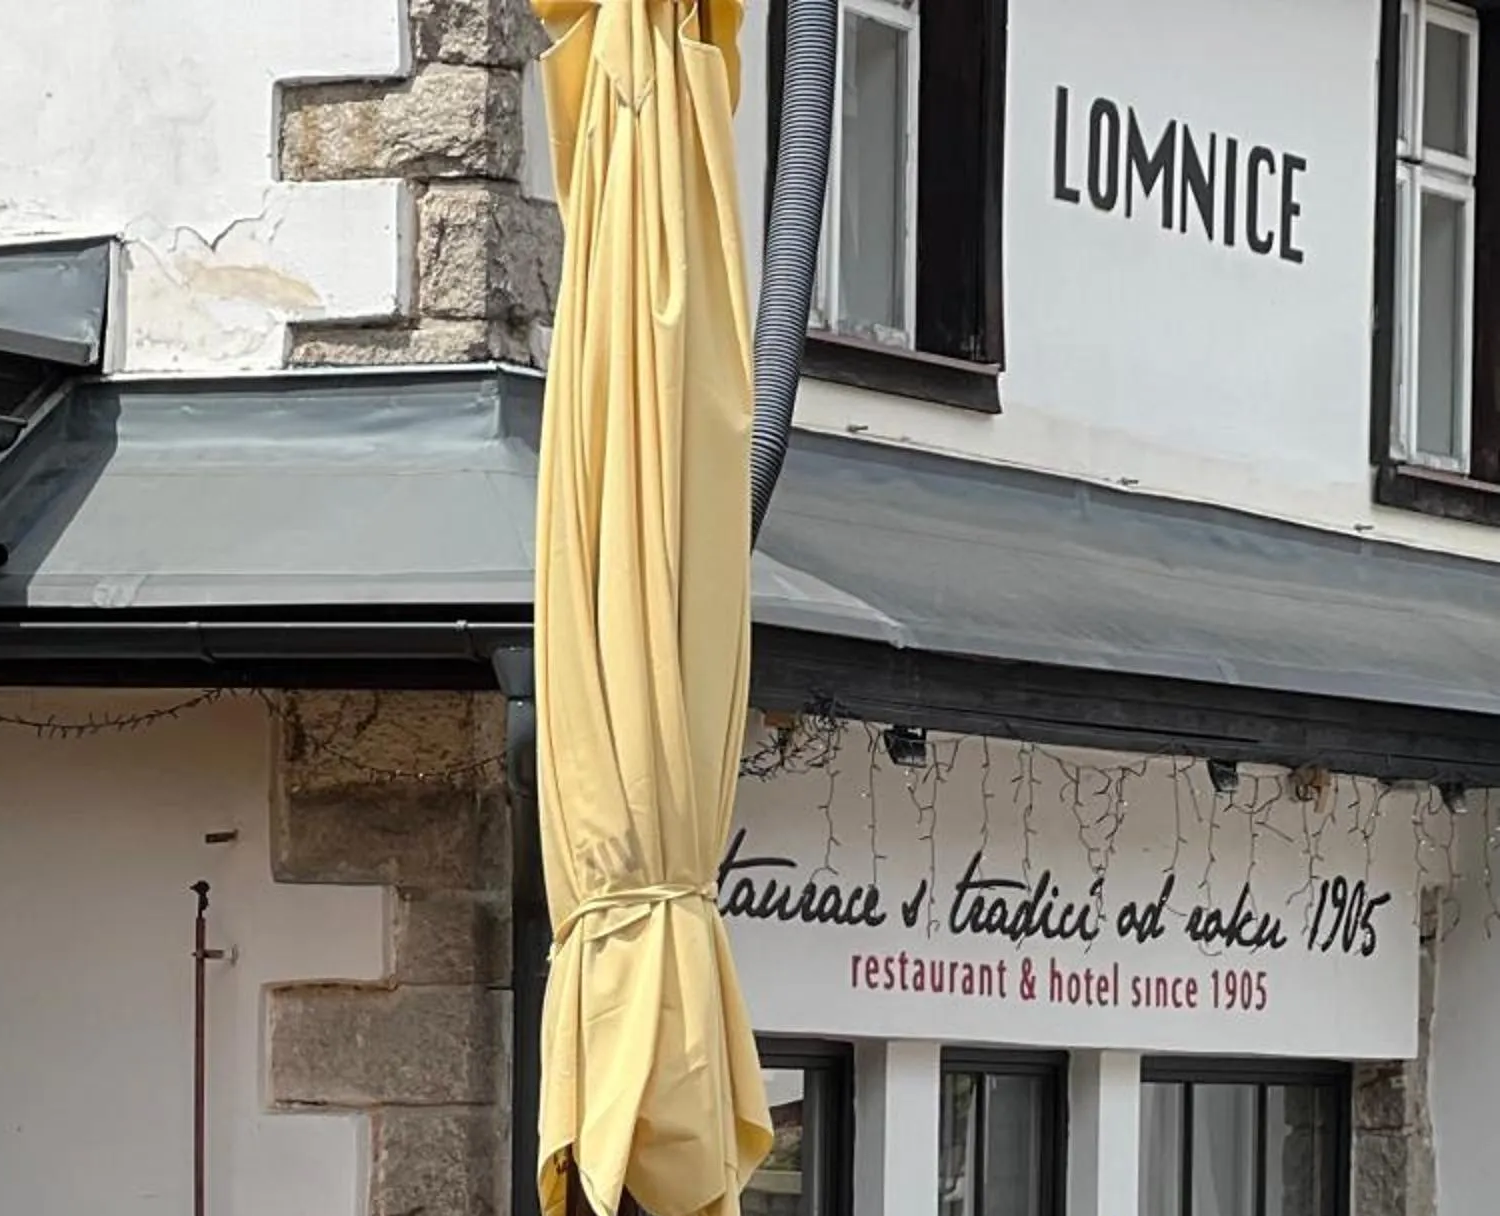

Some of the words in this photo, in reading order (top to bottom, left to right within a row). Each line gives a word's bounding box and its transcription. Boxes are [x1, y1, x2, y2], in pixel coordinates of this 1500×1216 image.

[1053, 84, 1307, 265] LOMNICE
[1117, 873, 1175, 943] od
[1184, 881, 1287, 949] roku
[1307, 875, 1392, 957] 1905
[851, 951, 1007, 998] restaurant
[1019, 956, 1037, 1001] &
[1050, 956, 1119, 1007] hotel
[1131, 975, 1199, 1009] since
[1211, 968, 1268, 1011] 1905
